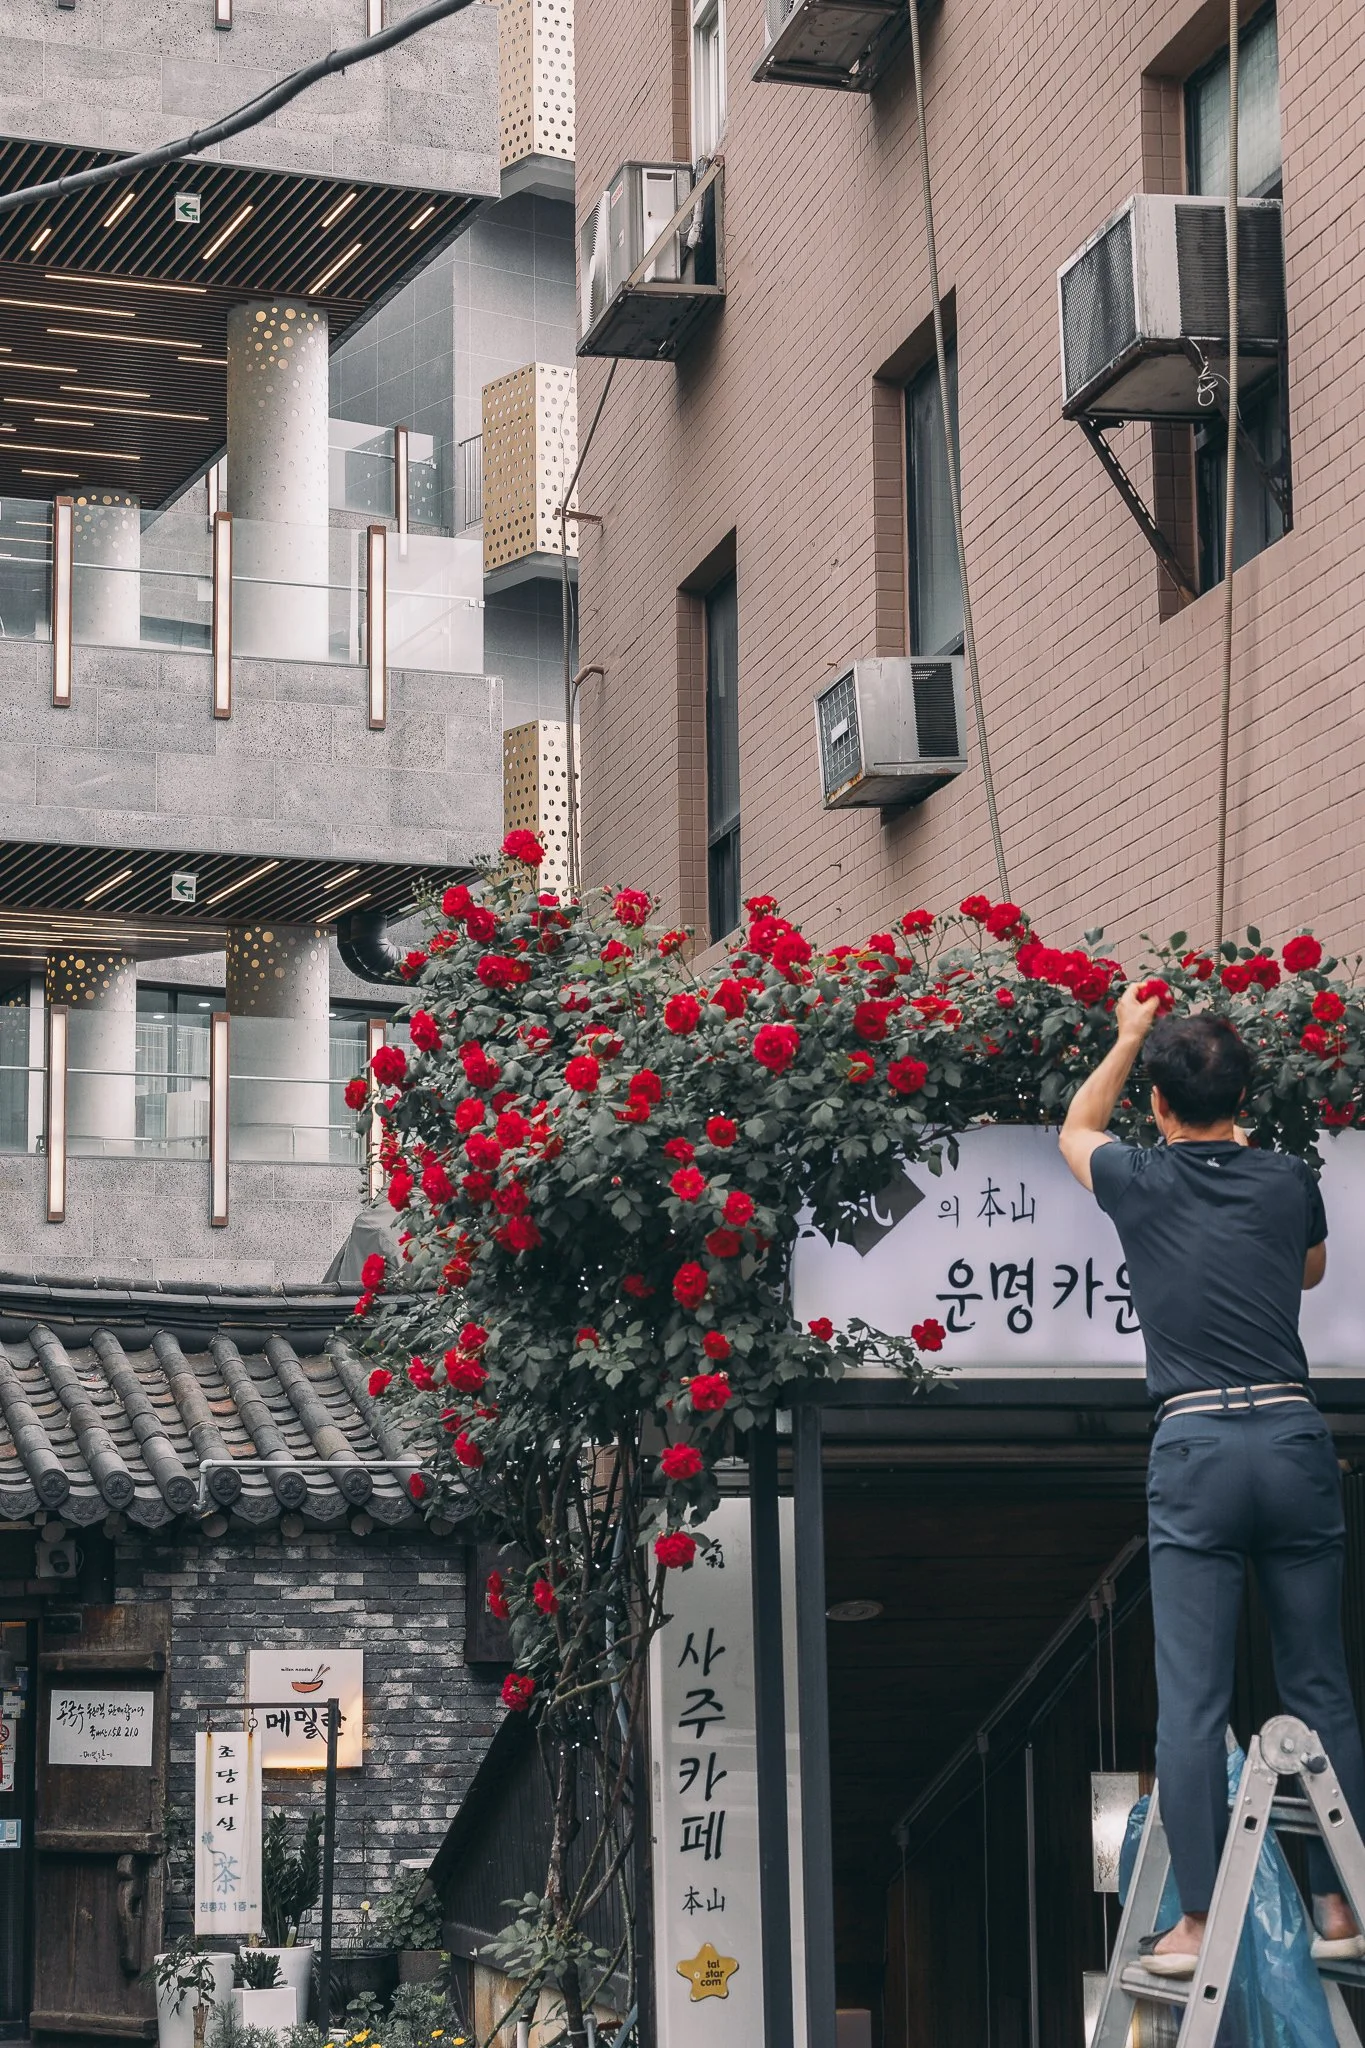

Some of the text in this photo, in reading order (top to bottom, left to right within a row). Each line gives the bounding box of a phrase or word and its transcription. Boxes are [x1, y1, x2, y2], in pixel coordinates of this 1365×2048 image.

[937, 1195, 960, 1228] 의
[976, 1177, 1036, 1228] 本山
[936, 1256, 1034, 1334] 운명
[677, 1627, 729, 1862] 사주카페
[214, 1744, 239, 1831] 초당다실
[212, 1856, 241, 1894] 茶
[681, 1886, 726, 1915] 本山
[705, 1970, 724, 1978] star
[707, 1959, 720, 1968] tal
